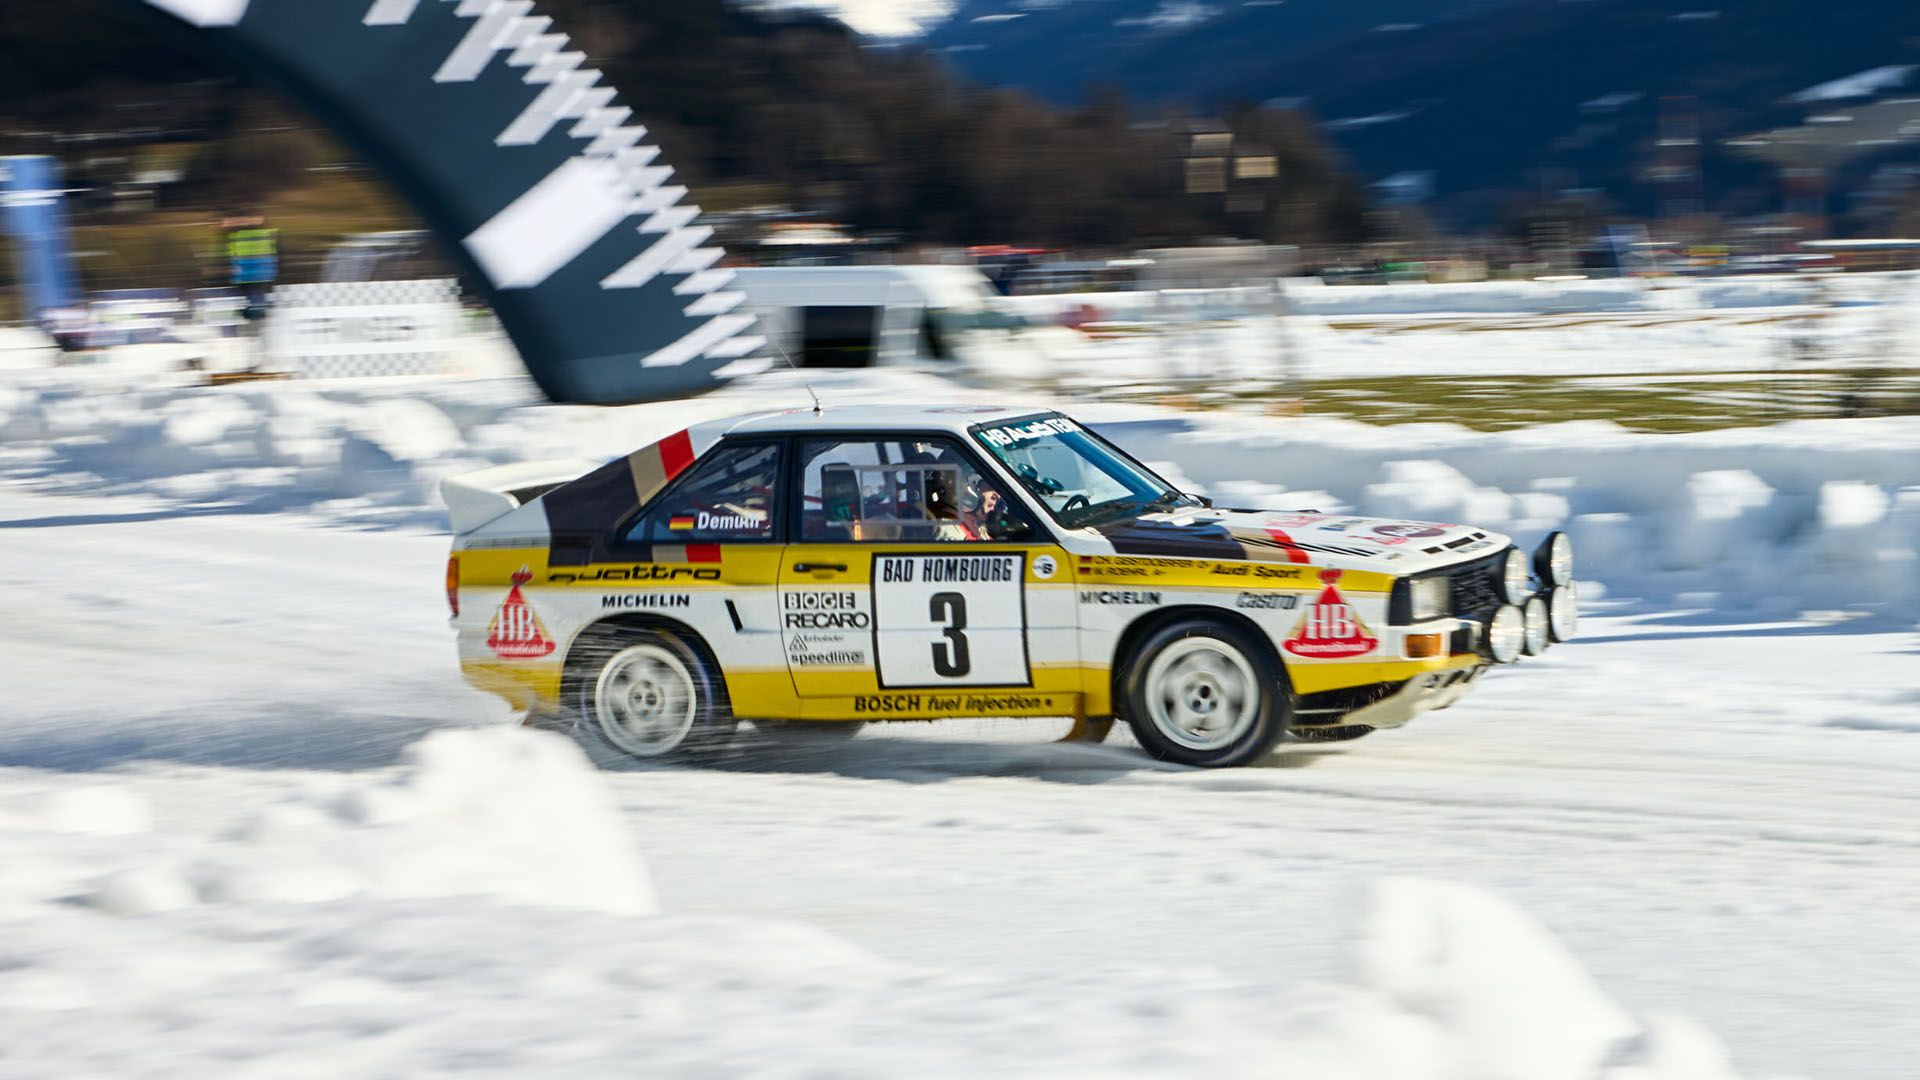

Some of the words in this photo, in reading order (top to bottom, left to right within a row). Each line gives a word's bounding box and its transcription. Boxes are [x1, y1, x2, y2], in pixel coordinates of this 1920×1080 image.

[980, 428, 1013, 448] HB
[548, 564, 721, 583] quattro
[884, 558, 913, 582] BAD
[923, 558, 1012, 582] HOMBOURG
[1211, 564, 1250, 576] Audi
[1254, 566, 1302, 579] Sport
[602, 594, 690, 608] MICHELIN
[785, 592, 855, 610] BOGE
[1081, 591, 1162, 605] MICHELIN
[1236, 592, 1301, 609] Castrol
[498, 605, 536, 641] HB
[785, 612, 869, 629] RECARO
[1306, 604, 1357, 638] HB
[929, 592, 970, 677] 3
[791, 652, 864, 665] speedline
[855, 695, 920, 712] BOSCH
[928, 695, 961, 711] fuel
[966, 694, 1041, 712] injection
